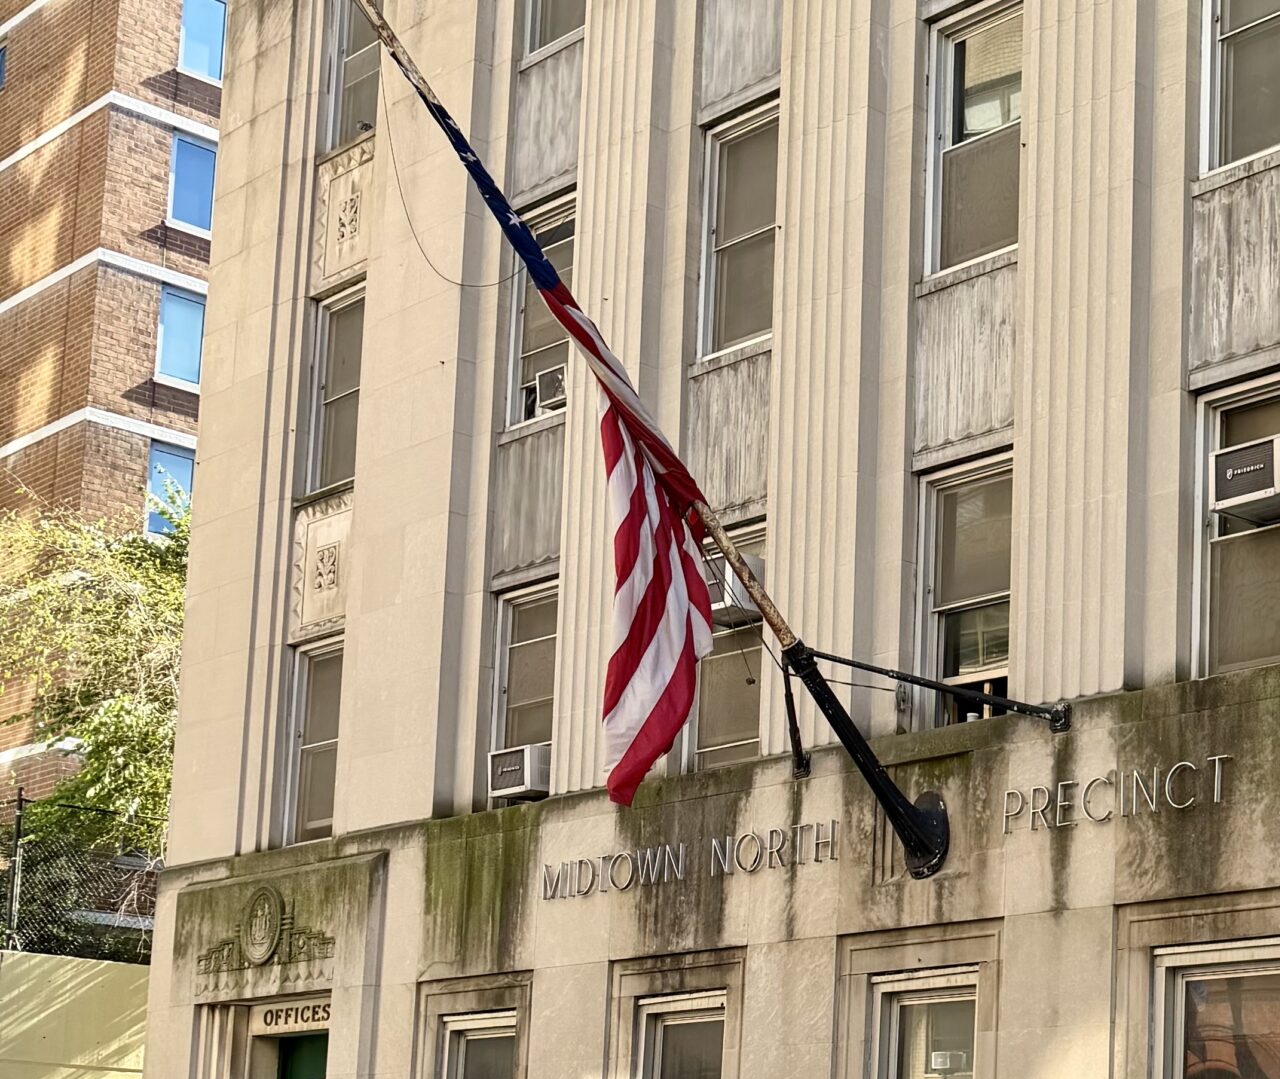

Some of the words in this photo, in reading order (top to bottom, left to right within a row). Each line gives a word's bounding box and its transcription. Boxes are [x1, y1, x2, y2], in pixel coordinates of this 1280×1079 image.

[542, 843, 687, 900] MIDTOWN
[711, 819, 839, 876] NORTH
[1003, 755, 1232, 834] PRECINCT
[263, 1003, 331, 1026] OFFICES
